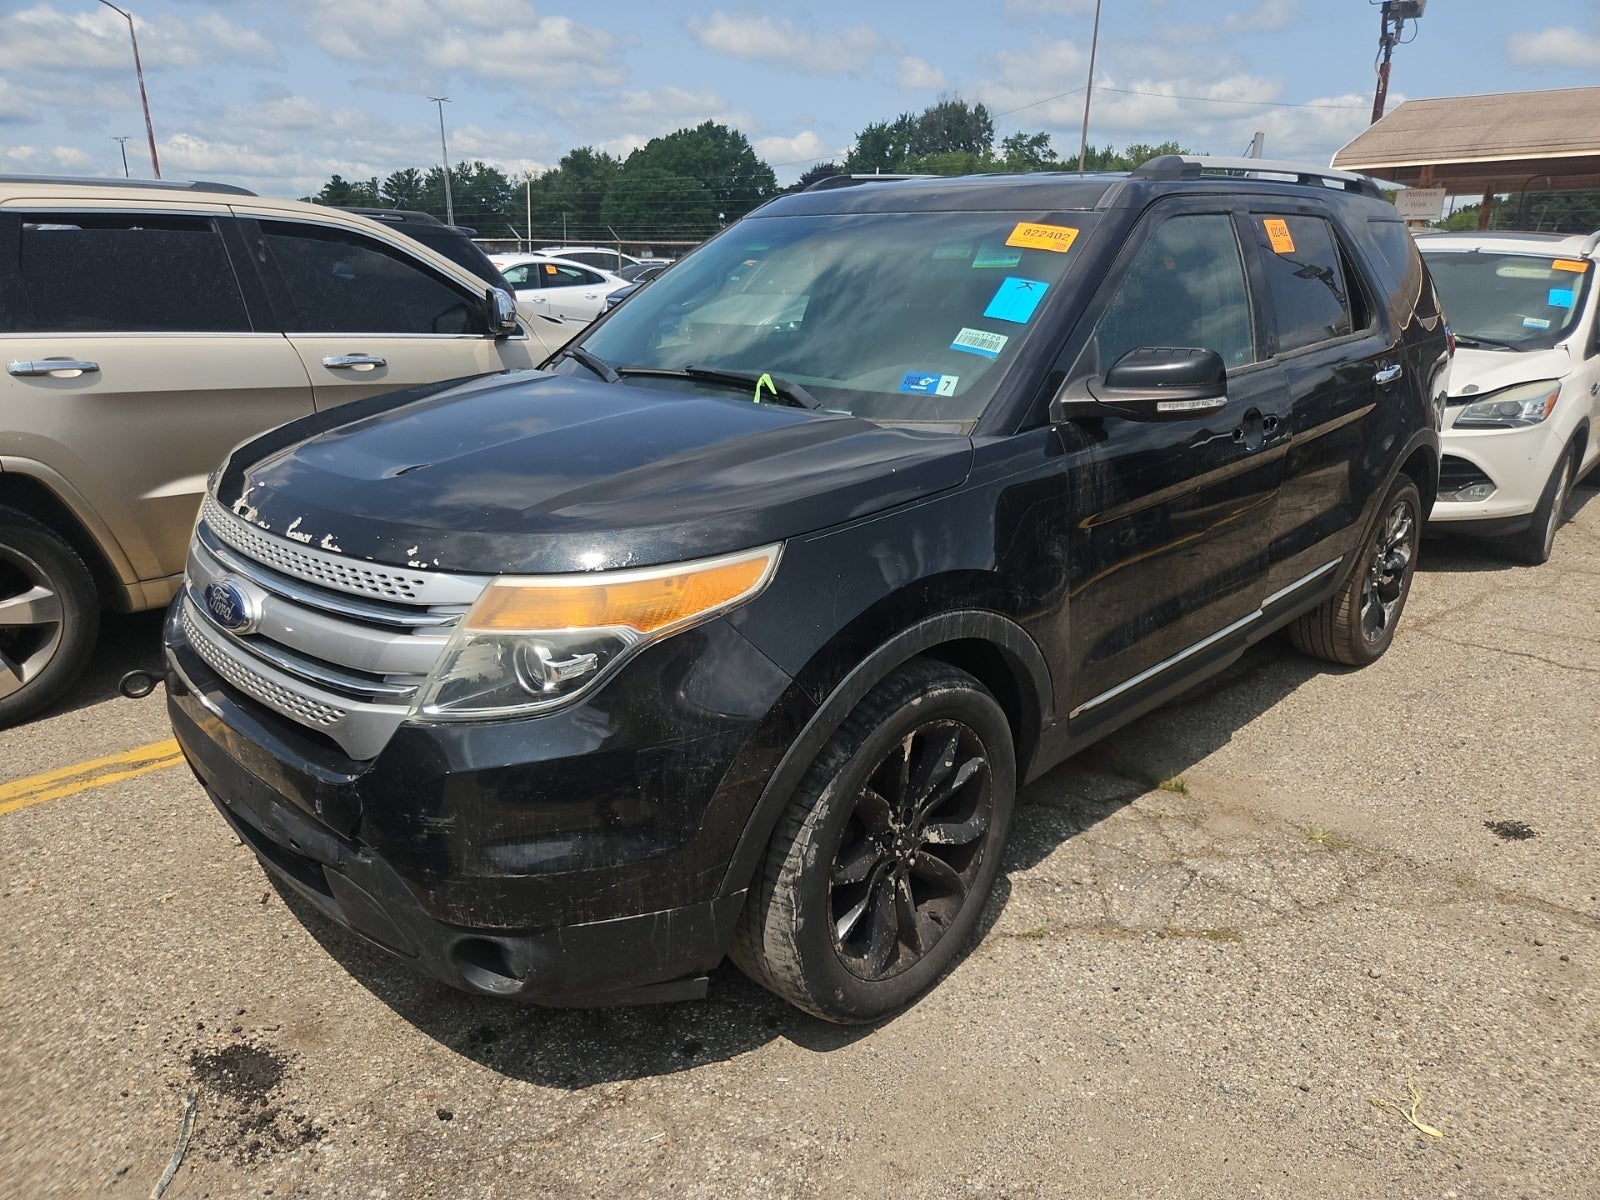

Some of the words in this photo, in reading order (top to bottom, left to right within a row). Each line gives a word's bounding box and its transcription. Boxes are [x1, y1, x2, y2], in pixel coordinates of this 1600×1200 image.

[1022, 228, 1071, 242] 822402
[943, 380, 951, 391] 7
[209, 586, 235, 621] Ford
